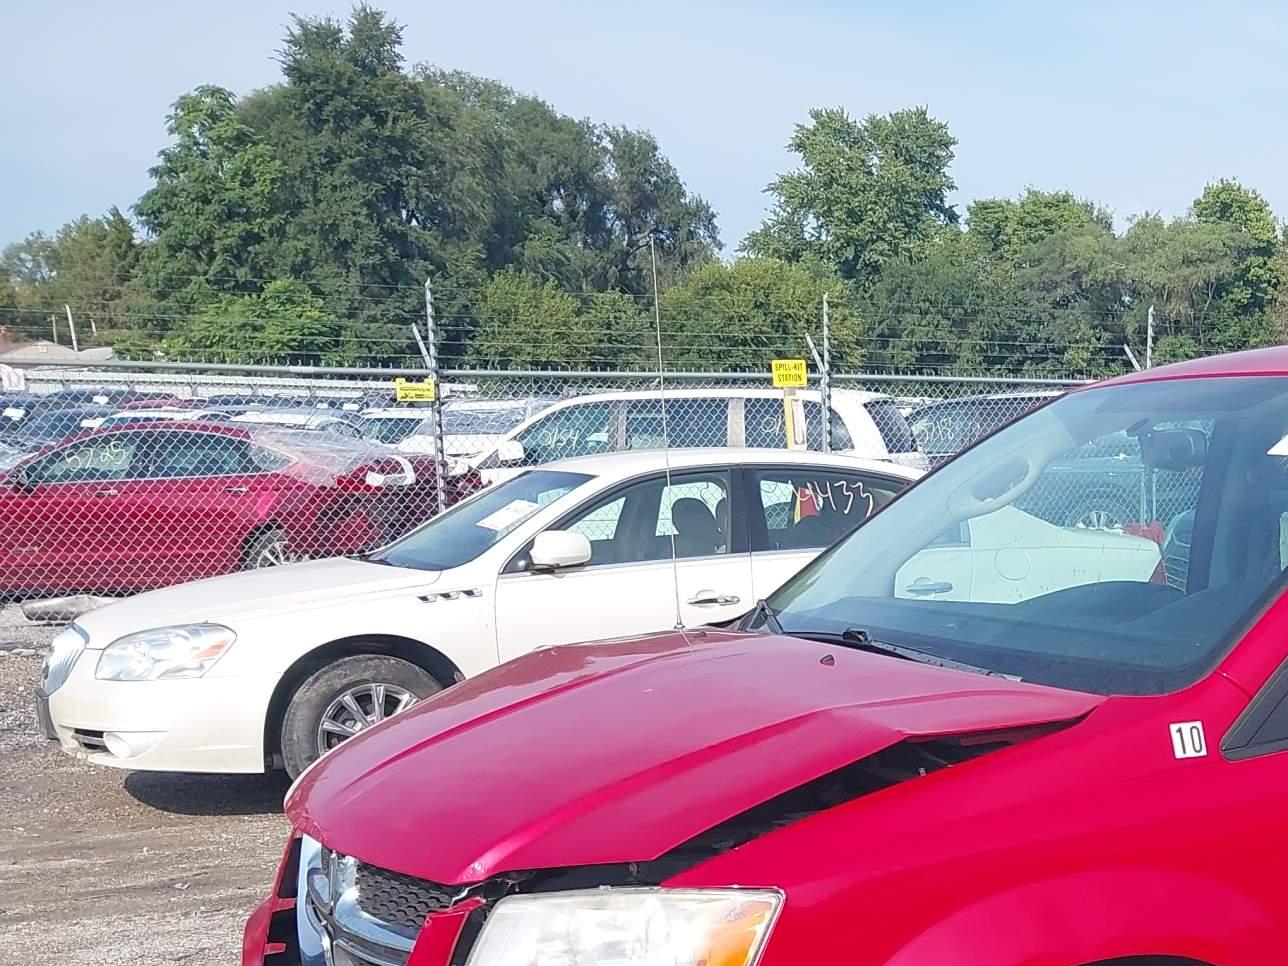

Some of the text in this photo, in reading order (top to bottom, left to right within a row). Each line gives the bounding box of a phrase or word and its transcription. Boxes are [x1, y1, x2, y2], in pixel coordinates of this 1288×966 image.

[775, 362, 803, 372] SPILL-KIT
[777, 373, 802, 383] STATION
[64, 441, 126, 472] 5725
[1175, 725, 1203, 755] 10
